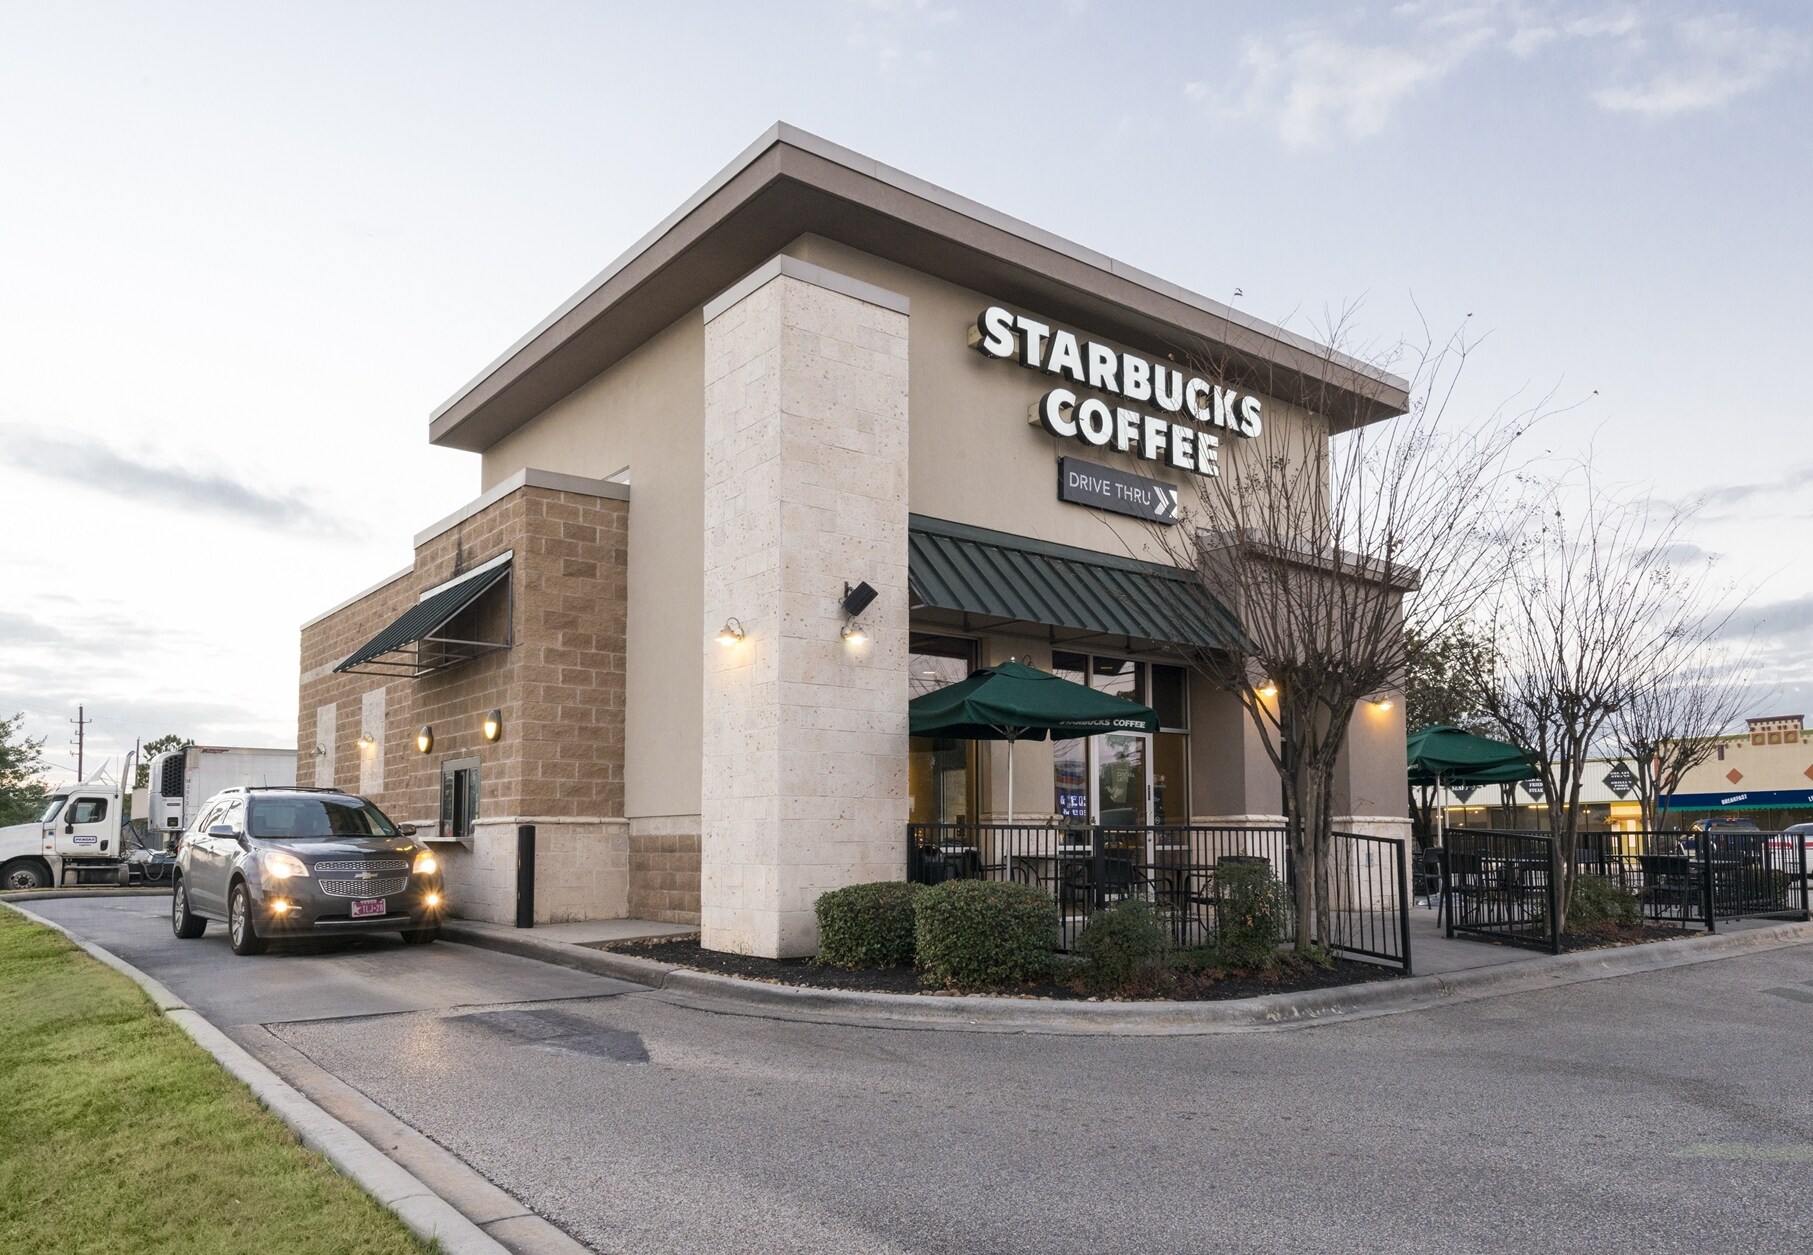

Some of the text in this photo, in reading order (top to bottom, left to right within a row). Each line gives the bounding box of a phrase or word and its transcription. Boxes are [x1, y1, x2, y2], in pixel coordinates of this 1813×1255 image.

[981, 306, 1262, 438] STARBUCKS
[1044, 388, 1220, 477] COFFEE
[1069, 471, 1151, 505] DRIVE THRU
[1113, 719, 1146, 728] COFFEE
[1721, 793, 1748, 805] BREAKFAST
